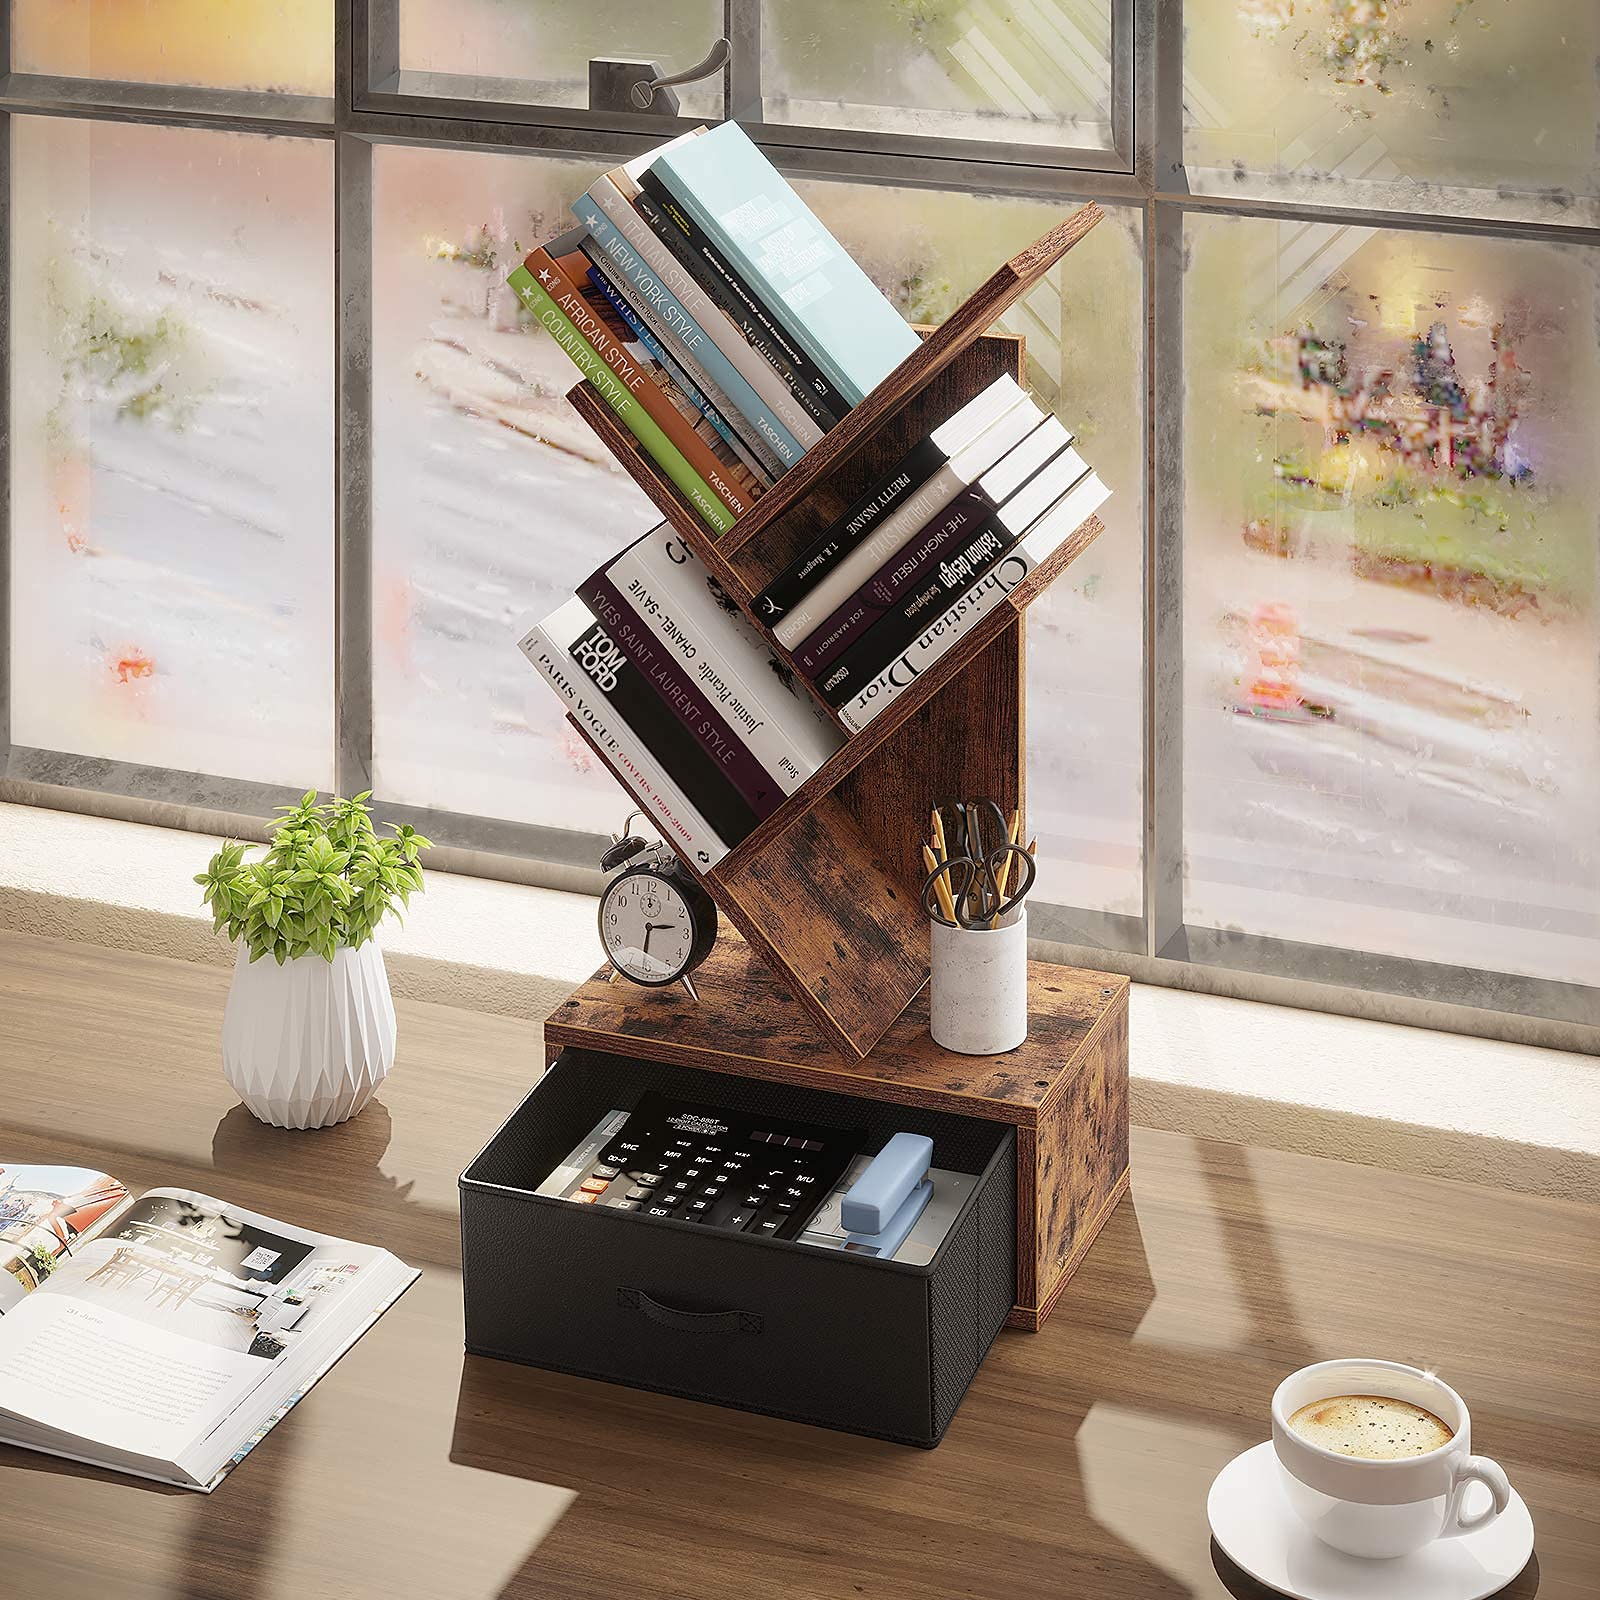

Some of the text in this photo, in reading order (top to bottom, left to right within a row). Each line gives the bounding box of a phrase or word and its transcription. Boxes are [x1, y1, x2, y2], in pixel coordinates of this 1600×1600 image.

[623, 220, 666, 272] ITALIAN
[664, 270, 705, 311] STYLE
[605, 237, 638, 272] NEW
[634, 268, 668, 310] YORK
[663, 306, 703, 350] STYLE
[702, 246, 725, 274] Spaces
[724, 273, 733, 283] of
[732, 281, 758, 314] Security
[758, 312, 771, 328] and
[770, 326, 802, 365] Insecurity
[558, 293, 644, 392] AFRICAN STYLE
[542, 310, 632, 416] COUNTRY STYLE
[740, 320, 820, 416] Madame Picasso
[774, 401, 811, 442] TASCHEN
[756, 417, 793, 460] TASCHEN
[708, 471, 744, 514] TASCHEN
[846, 473, 911, 536] PRETTY INSANE
[690, 488, 726, 530] TASCHEN
[898, 496, 935, 534] ITALIAN
[798, 542, 839, 580] T. R. Mangrove
[892, 512, 968, 588] THE NIGHT ITSELF
[938, 529, 1003, 589] Fashion design
[782, 610, 812, 640] TASCHEN
[816, 624, 850, 655] MARRIOTT
[859, 556, 1028, 710] Christian Dior
[588, 626, 628, 674] TOM
[573, 640, 618, 692] FORD
[593, 590, 736, 764] YVES SAINT LAURENT STYLE
[699, 662, 764, 735] Justine Picardie
[538, 654, 692, 842] PARIS VOGUE COVERS 1920-2009
[778, 756, 800, 780] Steidl
[618, 895, 628, 908] 10
[632, 883, 640, 896] 11
[646, 881, 657, 893] 12
[610, 914, 618, 926] 9
[678, 906, 685, 918] 2
[614, 934, 622, 946] 8
[682, 928, 690, 940] 3
[664, 960, 671, 970] 5
[676, 948, 683, 958] 4
[681, 1113, 720, 1125] SDC-888T
[621, 1142, 640, 1151] MC
[646, 1176, 656, 1184] 4
[658, 1164, 668, 1172] 7
[724, 1162, 742, 1170] M+
[796, 1174, 815, 1184] MU
[664, 1195, 676, 1203] 2
[675, 1182, 688, 1190] 5
[618, 1200, 631, 1208] 0
[650, 1207, 668, 1216] 00
